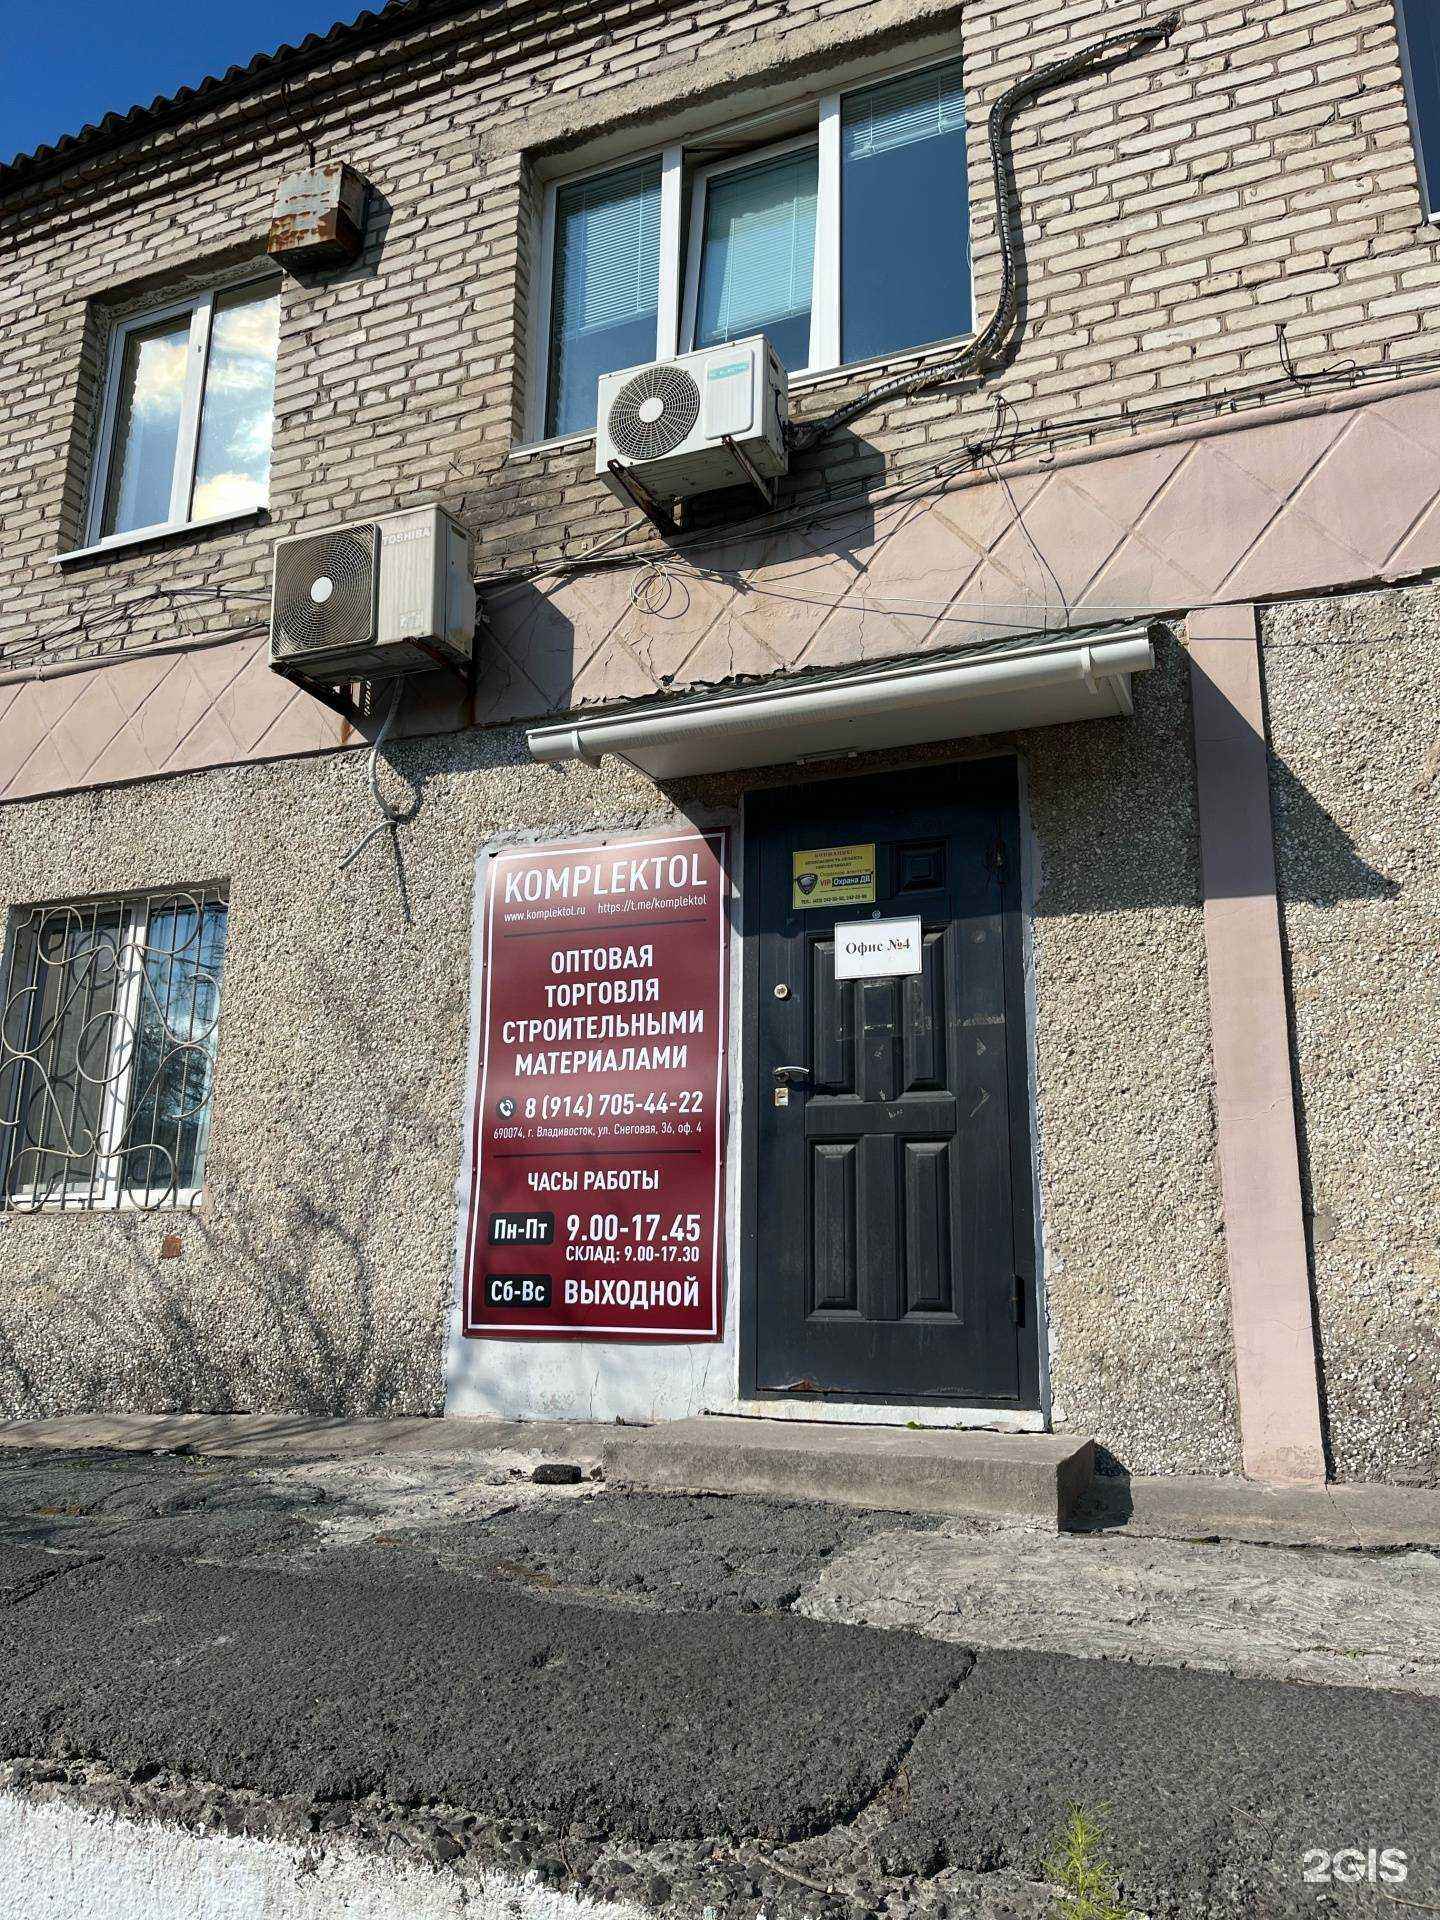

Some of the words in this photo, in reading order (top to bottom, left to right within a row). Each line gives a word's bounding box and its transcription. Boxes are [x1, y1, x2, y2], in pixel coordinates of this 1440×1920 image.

[383, 527, 431, 546] TOSHIBA
[504, 853, 708, 904] KOMPLEKTOL
[504, 905, 586, 922] www.komplektol.ru
[597, 894, 707, 915] https://t.me/komplektol
[551, 944, 653, 974] ОПТОВАЯ
[845, 941, 882, 956] Офис
[887, 937, 911, 951] №4
[544, 978, 659, 1008] ТОРГОВЛЯ
[502, 1009, 704, 1044] СТРОИТЕЛЬНЫМИ
[515, 1045, 688, 1076] МАТЕРИАЛАМИ
[525, 1097, 537, 1119] 8
[541, 1092, 593, 1120] (914)
[599, 1090, 704, 1116] 705-44-22
[493, 1126, 526, 1140] 690074,
[527, 1128, 534, 1138] г.
[537, 1125, 596, 1138] Владивосток,
[597, 1126, 611, 1138] ул.
[613, 1123, 658, 1136] Снеговая,
[661, 1121, 675, 1134] 36,
[677, 1120, 693, 1136] оф.
[696, 1120, 702, 1133] 4
[527, 1170, 578, 1191] ЧАСЫ
[583, 1169, 659, 1191] РАБОТЫ
[494, 1218, 548, 1240] Пн-Пт
[566, 1213, 701, 1242] 9.00-17.45
[565, 1245, 620, 1264] СКЛАД:
[625, 1245, 700, 1262] 9.00-17.30
[490, 1280, 545, 1302] Сб-Вс
[564, 1276, 699, 1310] ВЫХОДНОЙ
